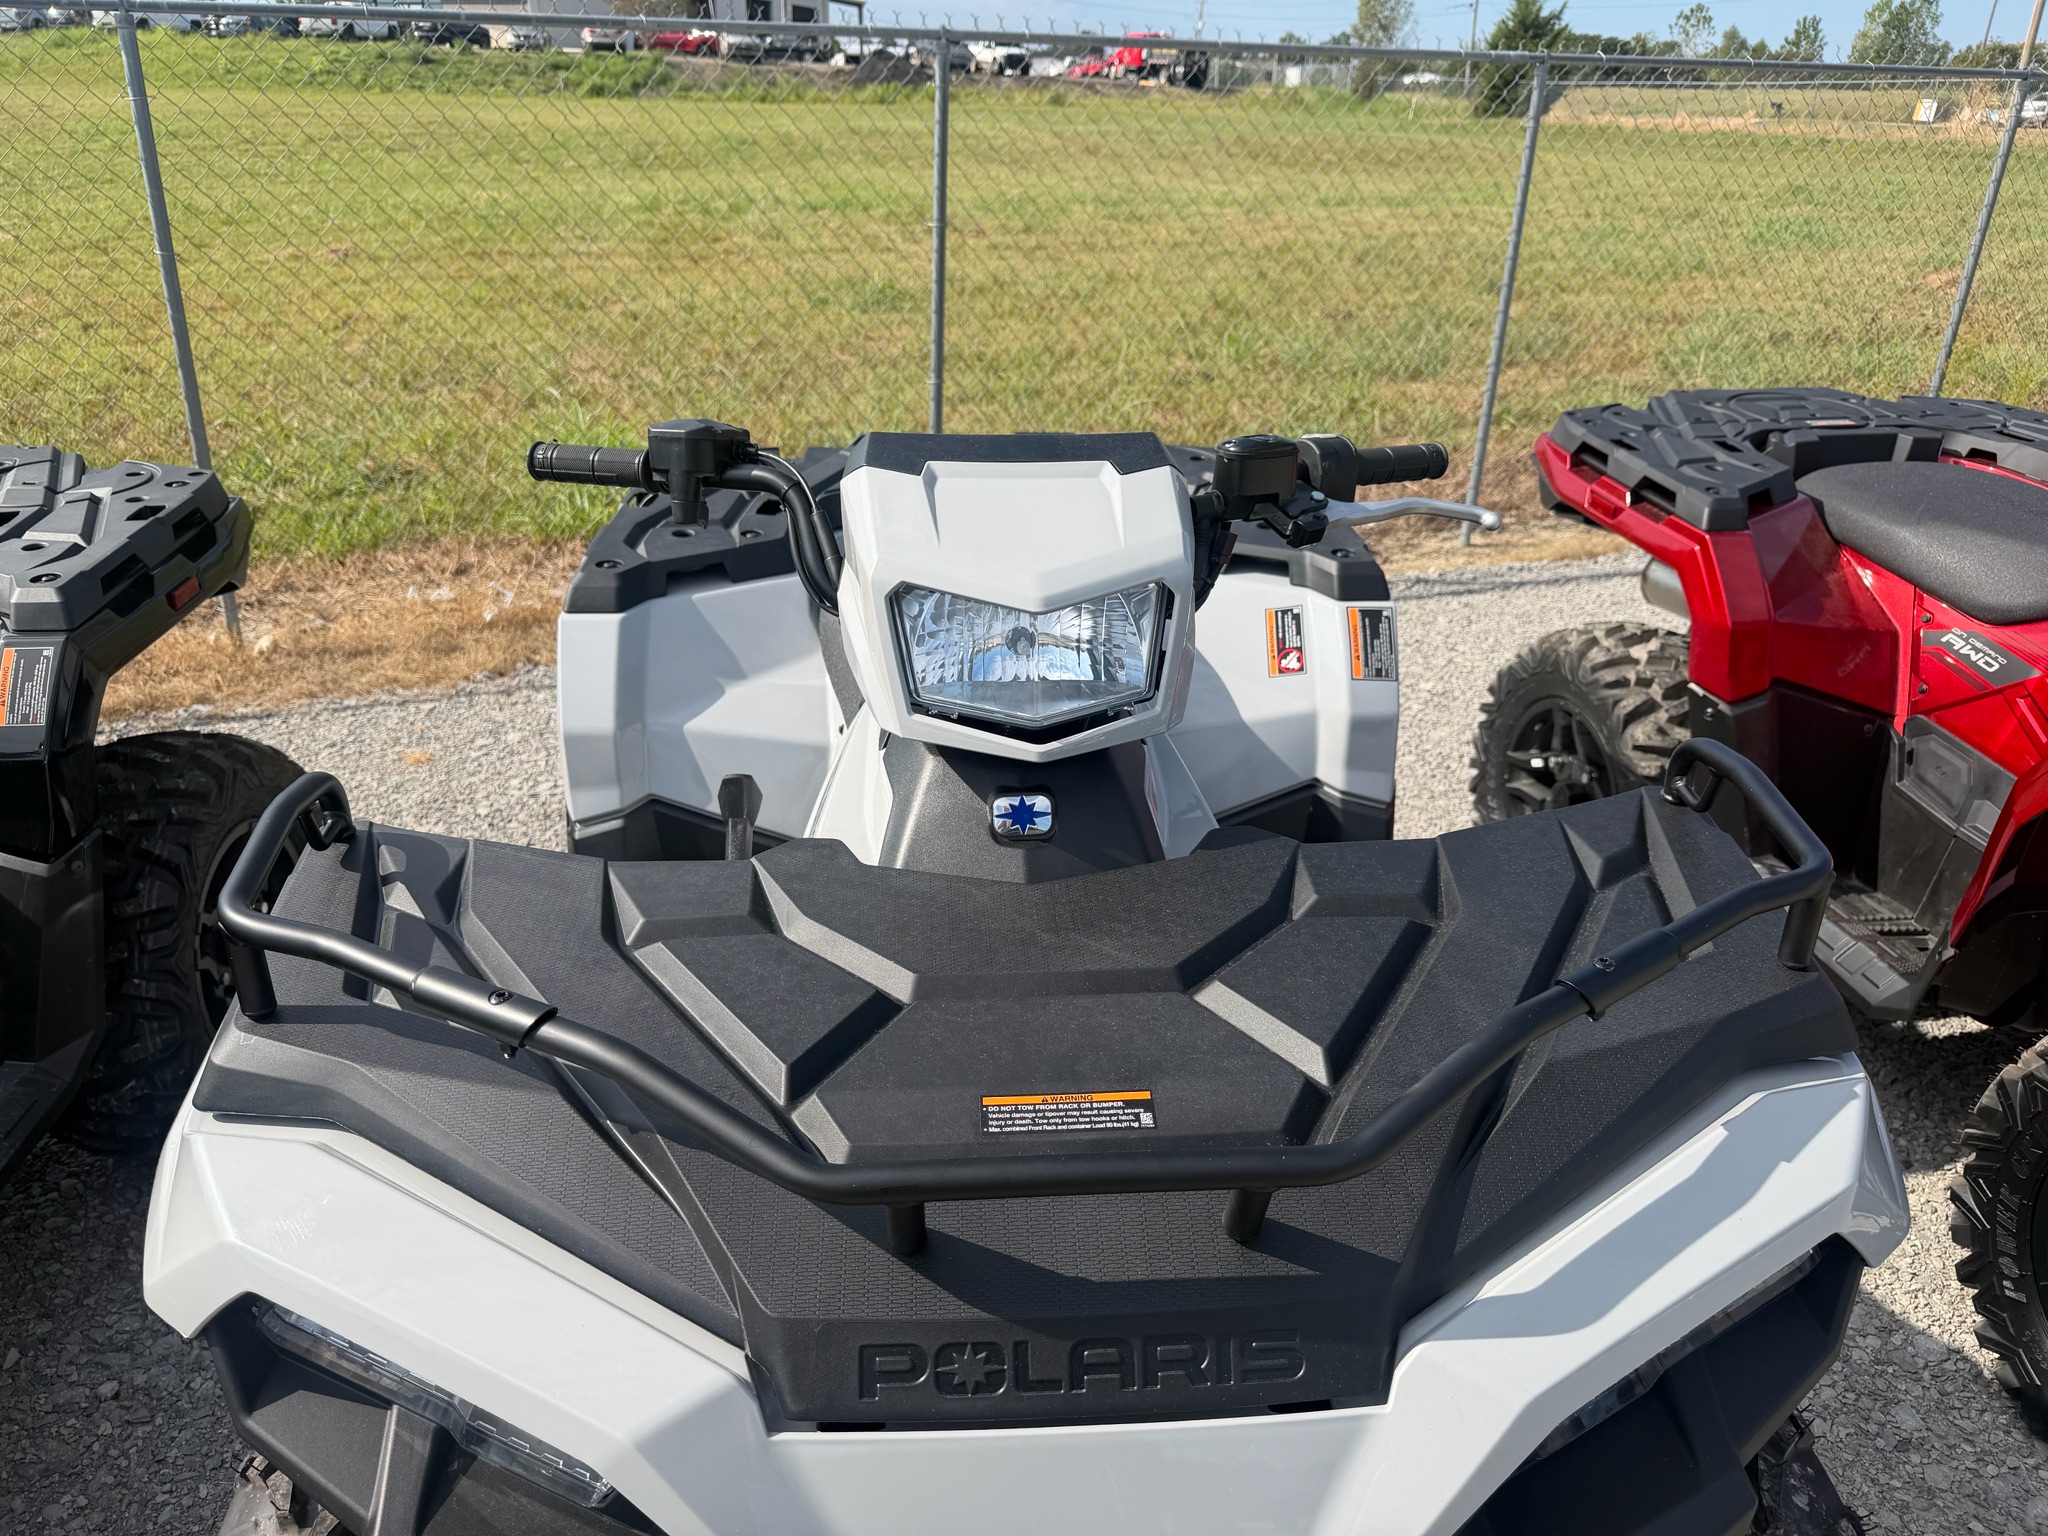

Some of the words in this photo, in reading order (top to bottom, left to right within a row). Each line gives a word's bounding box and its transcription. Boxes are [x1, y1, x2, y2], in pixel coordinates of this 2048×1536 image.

[1940, 633, 2000, 673] AWD
[1951, 627, 1967, 639] ON
[1968, 638, 2008, 665] DEMAND
[0, 666, 10, 698] WARNING
[1050, 1094, 1094, 1102] WARNING
[1995, 1182, 2027, 1303] POWER
[858, 1328, 1306, 1402] POLARIS
